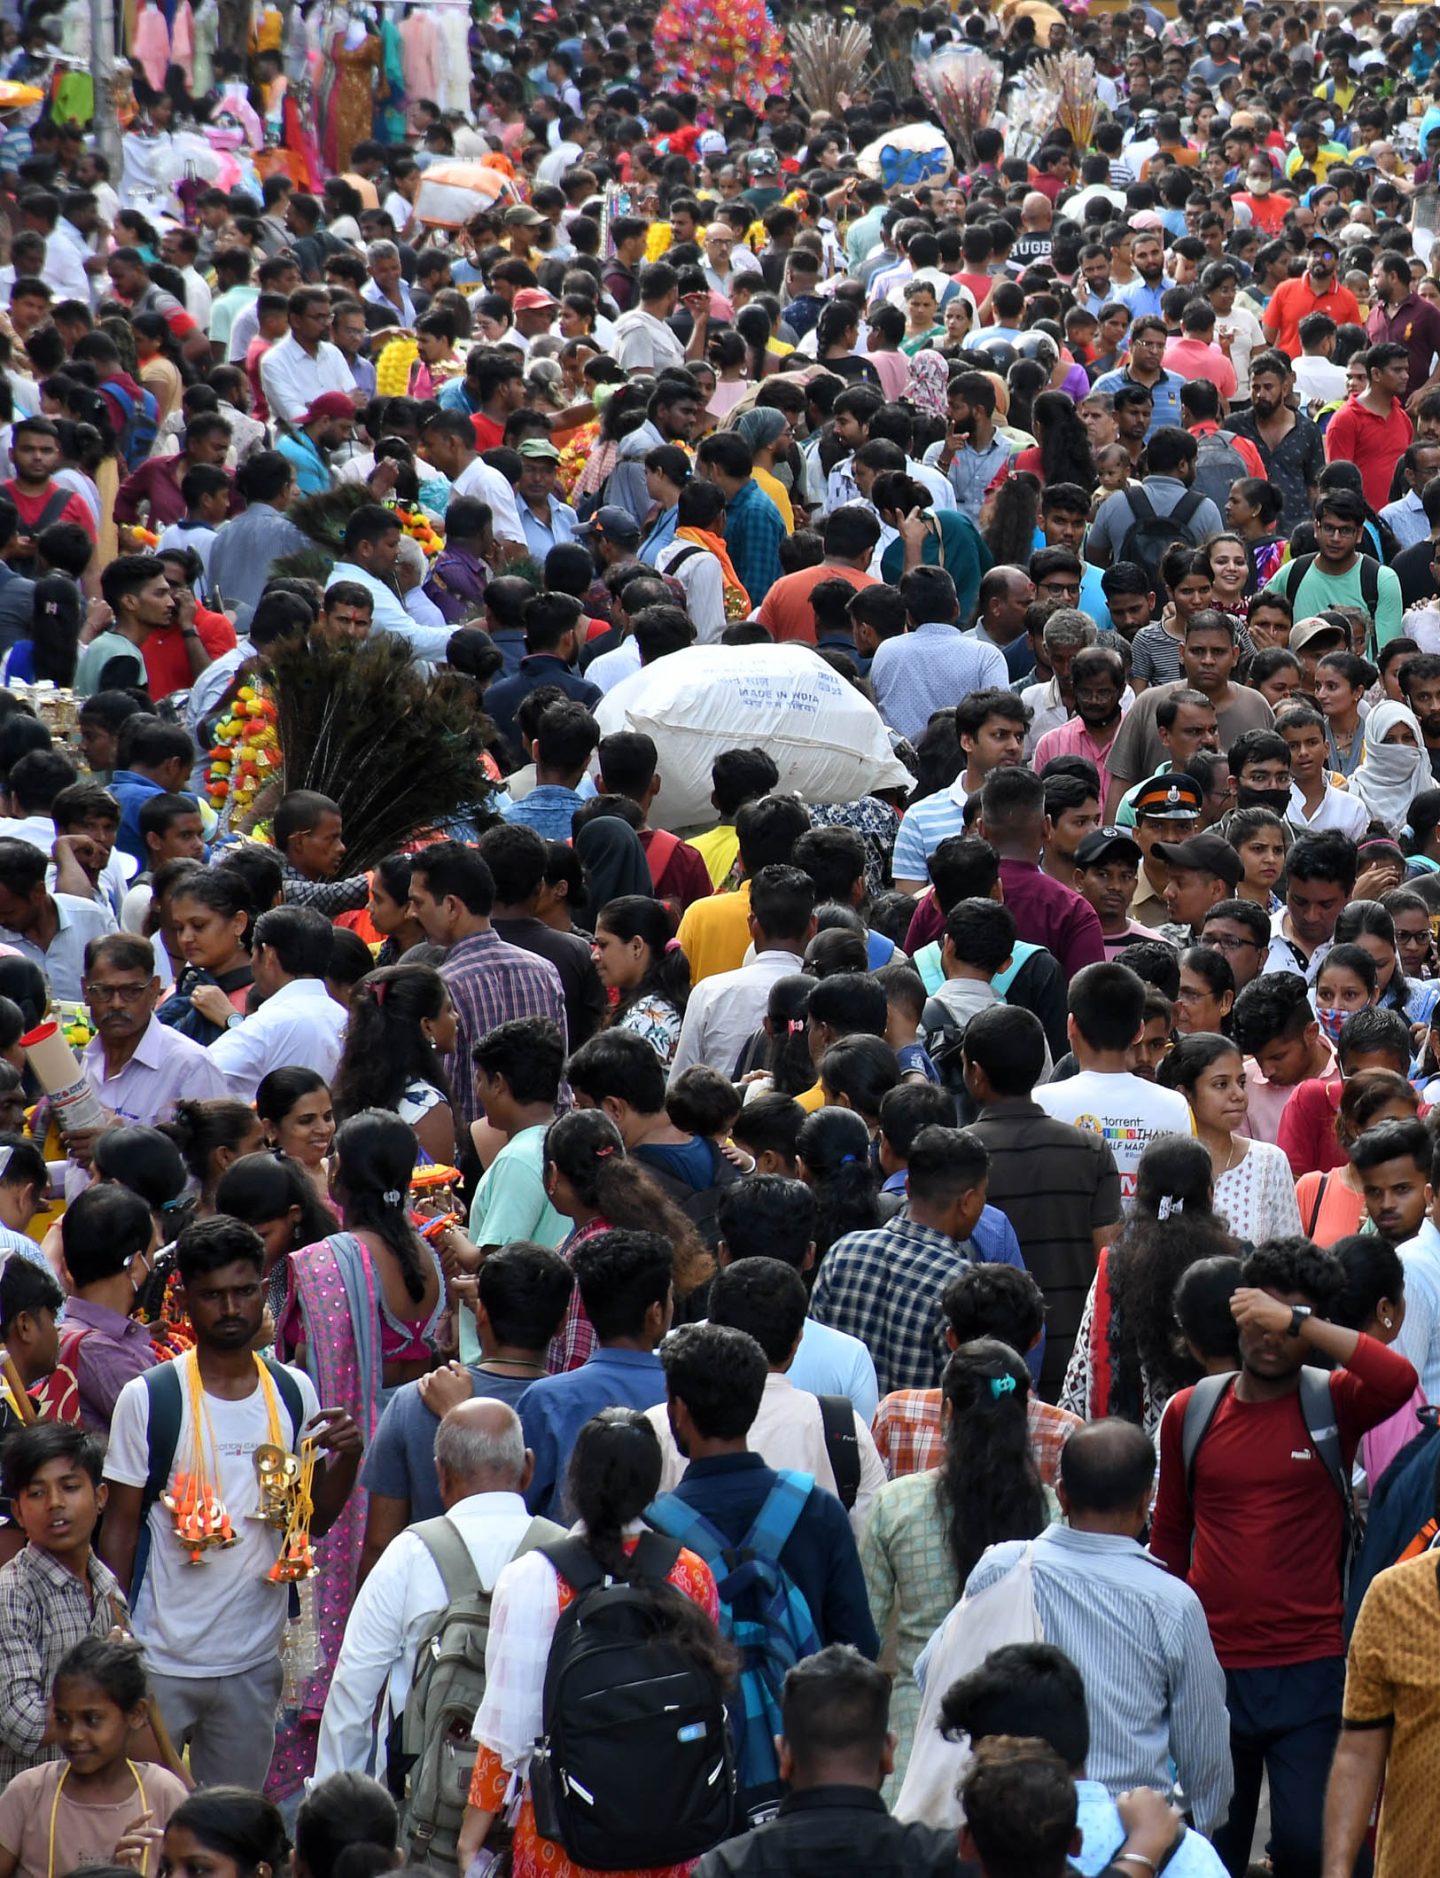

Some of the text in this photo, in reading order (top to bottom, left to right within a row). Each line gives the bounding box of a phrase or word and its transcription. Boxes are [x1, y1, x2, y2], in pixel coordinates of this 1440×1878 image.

[739, 688, 772, 699] MADE
[776, 689, 788, 700] IN
[1101, 1116, 1145, 1127] torrent
[1107, 1141, 1123, 1151] ALF
[216, 1443, 242, 1451] OTTON
